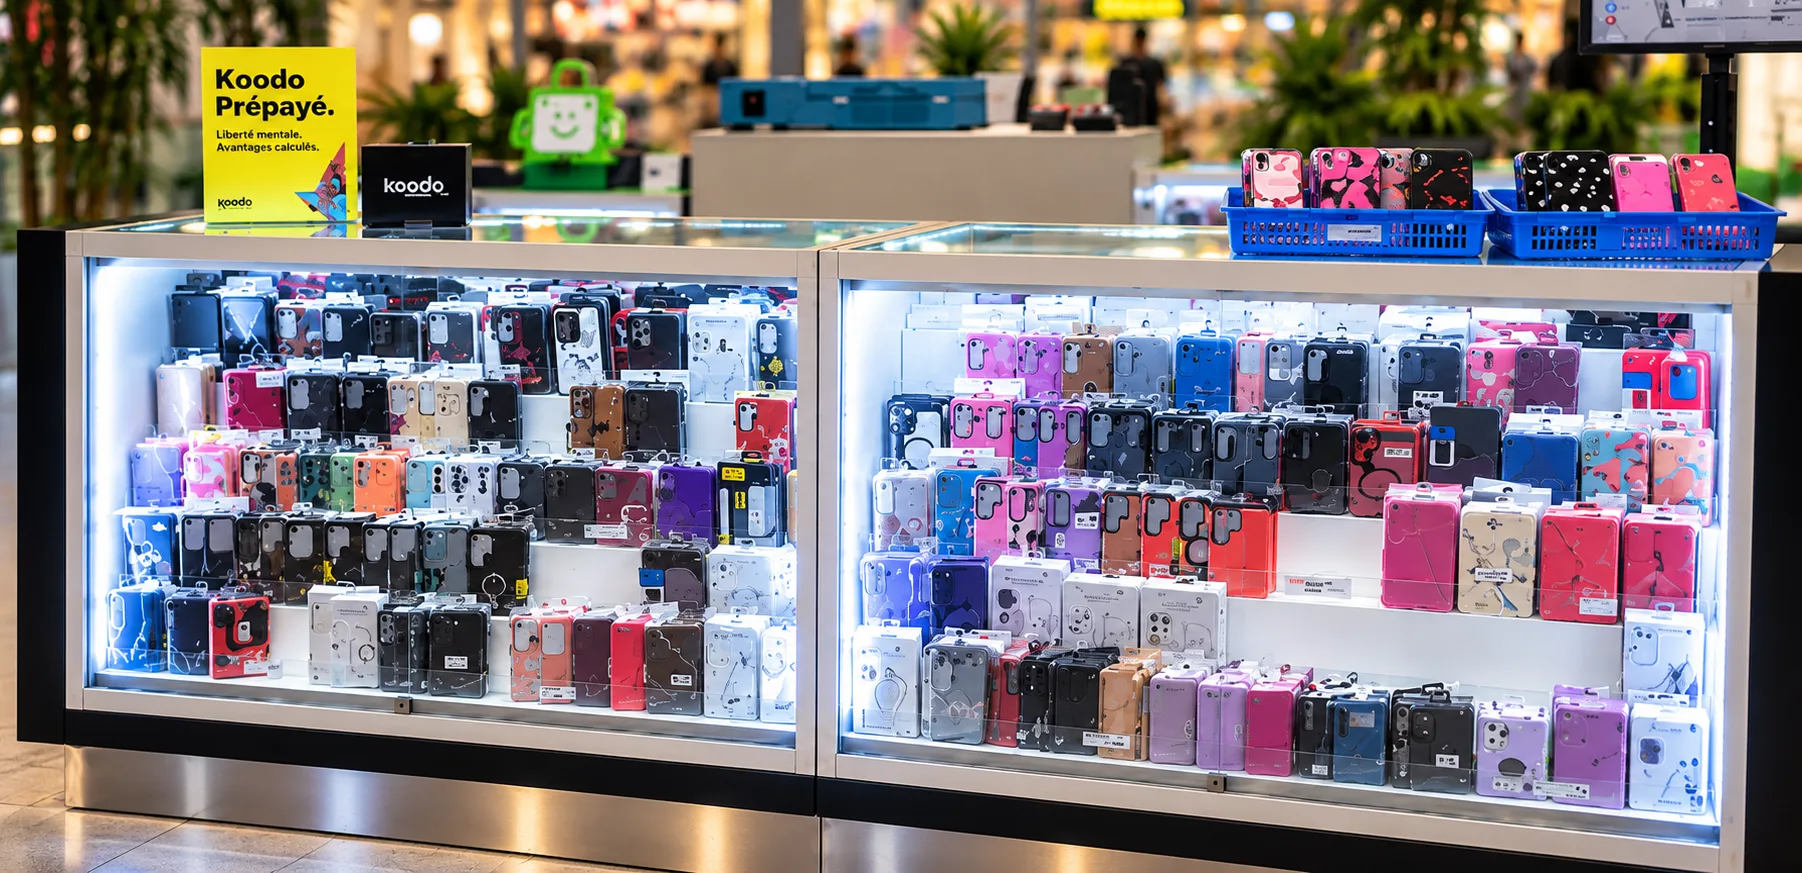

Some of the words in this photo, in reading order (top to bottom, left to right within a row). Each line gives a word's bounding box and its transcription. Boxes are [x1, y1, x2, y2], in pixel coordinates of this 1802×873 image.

[215, 68, 305, 90] Koodo
[215, 95, 335, 122] Prépayé.
[216, 129, 254, 140] Liberté
[256, 129, 303, 140] mentale.
[216, 142, 273, 154] Avantages
[274, 141, 320, 152] calculés.
[383, 175, 444, 193] koodo
